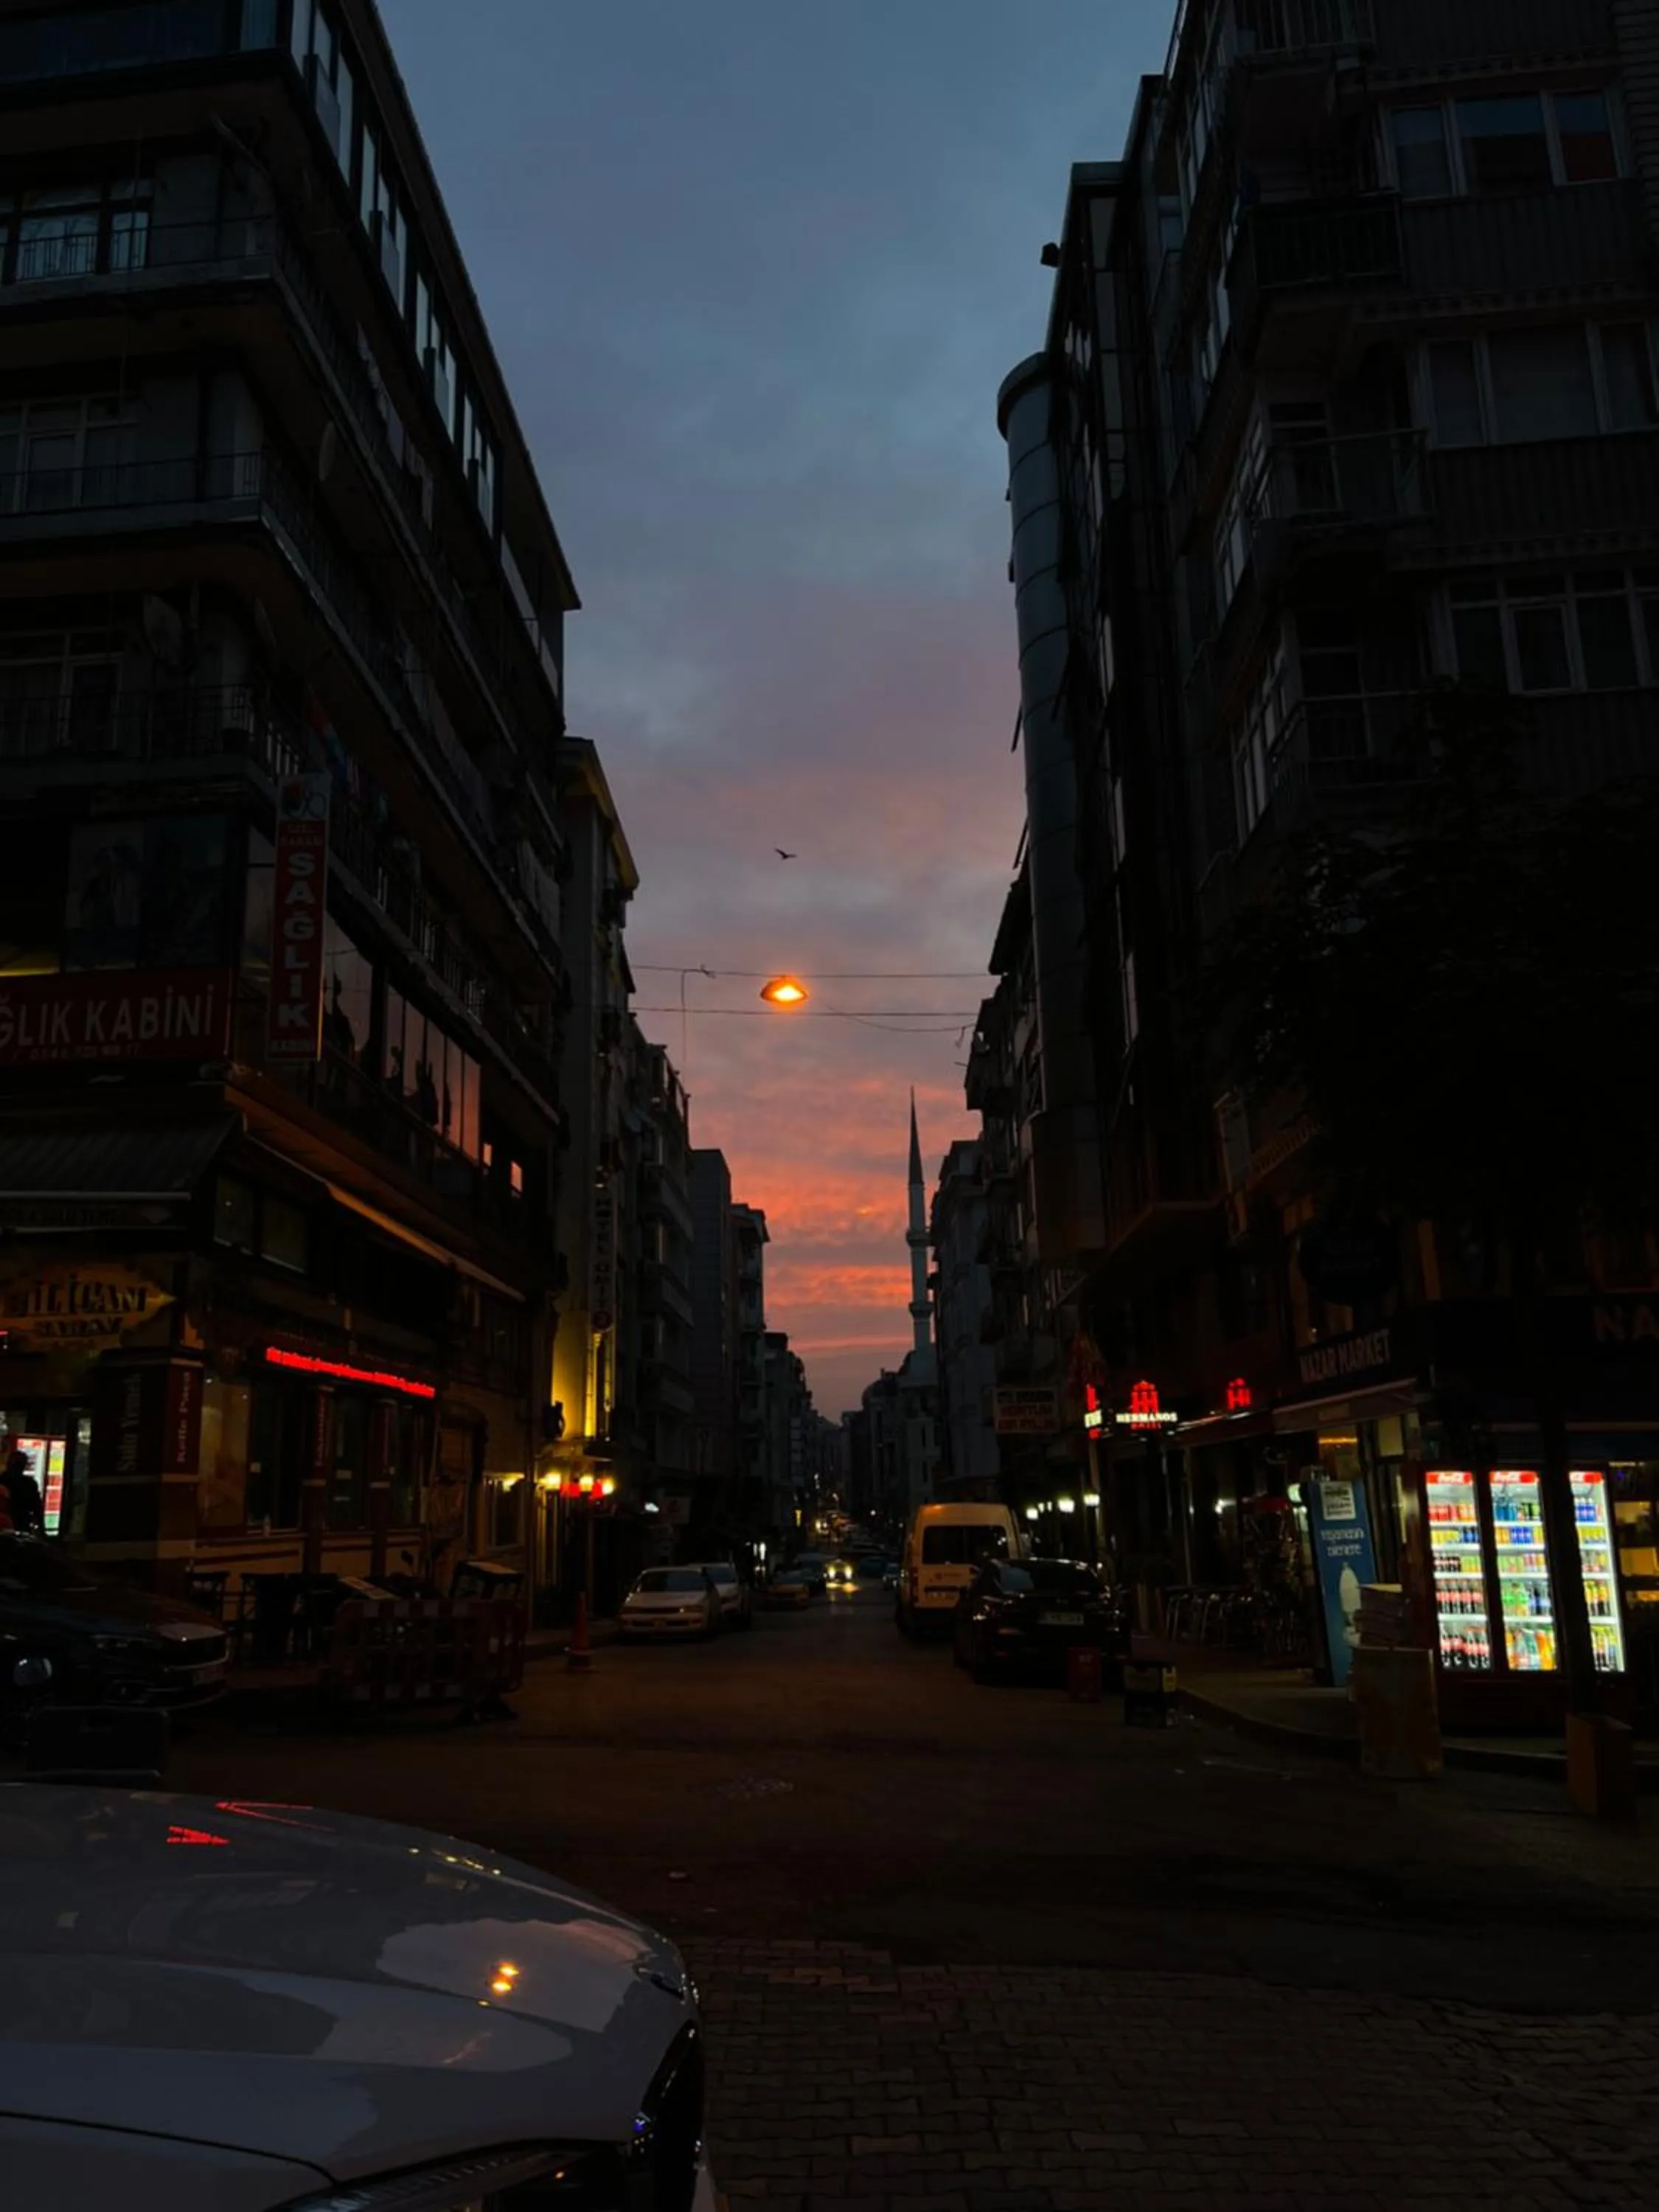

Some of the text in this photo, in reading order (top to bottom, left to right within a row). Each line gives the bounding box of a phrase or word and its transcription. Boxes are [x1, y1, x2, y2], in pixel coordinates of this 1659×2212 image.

[277, 852, 316, 1027] SAĞLIK
[83, 983, 215, 1043] KABİNİ
[1300, 1327, 1391, 1384] NAZAR MARKET
[1116, 1411, 1178, 1424] HERMANOS
